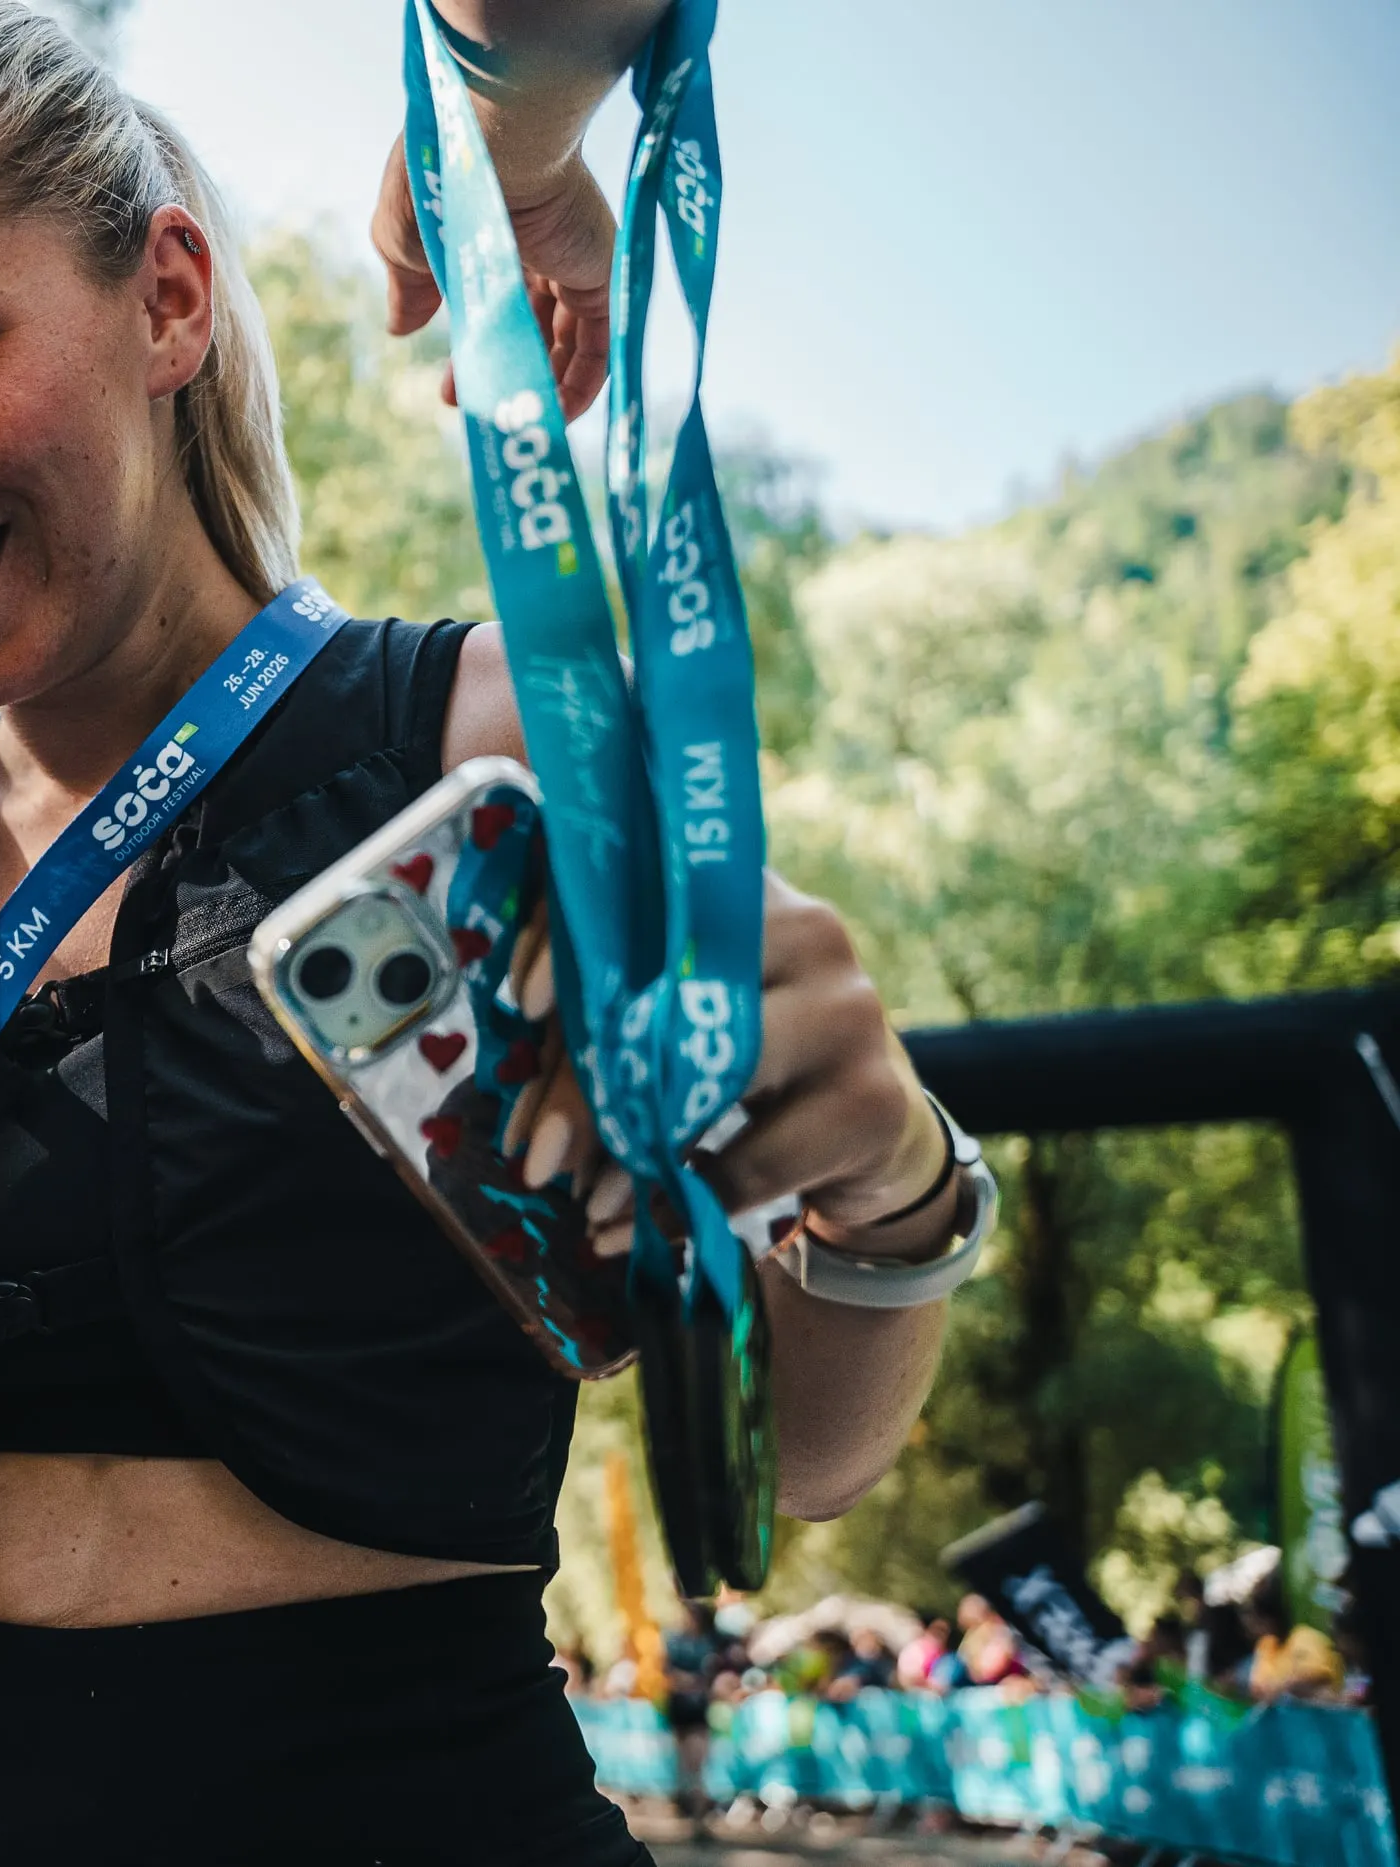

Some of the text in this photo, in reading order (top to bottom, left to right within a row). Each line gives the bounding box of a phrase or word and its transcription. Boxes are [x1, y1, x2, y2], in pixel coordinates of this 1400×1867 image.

[238, 653, 289, 710] JUN 2026
[92, 740, 196, 851] soča
[114, 766, 206, 862] OUTDOOR FESTIVAL
[682, 741, 730, 867] 15 KM
[6, 906, 51, 960] KM
